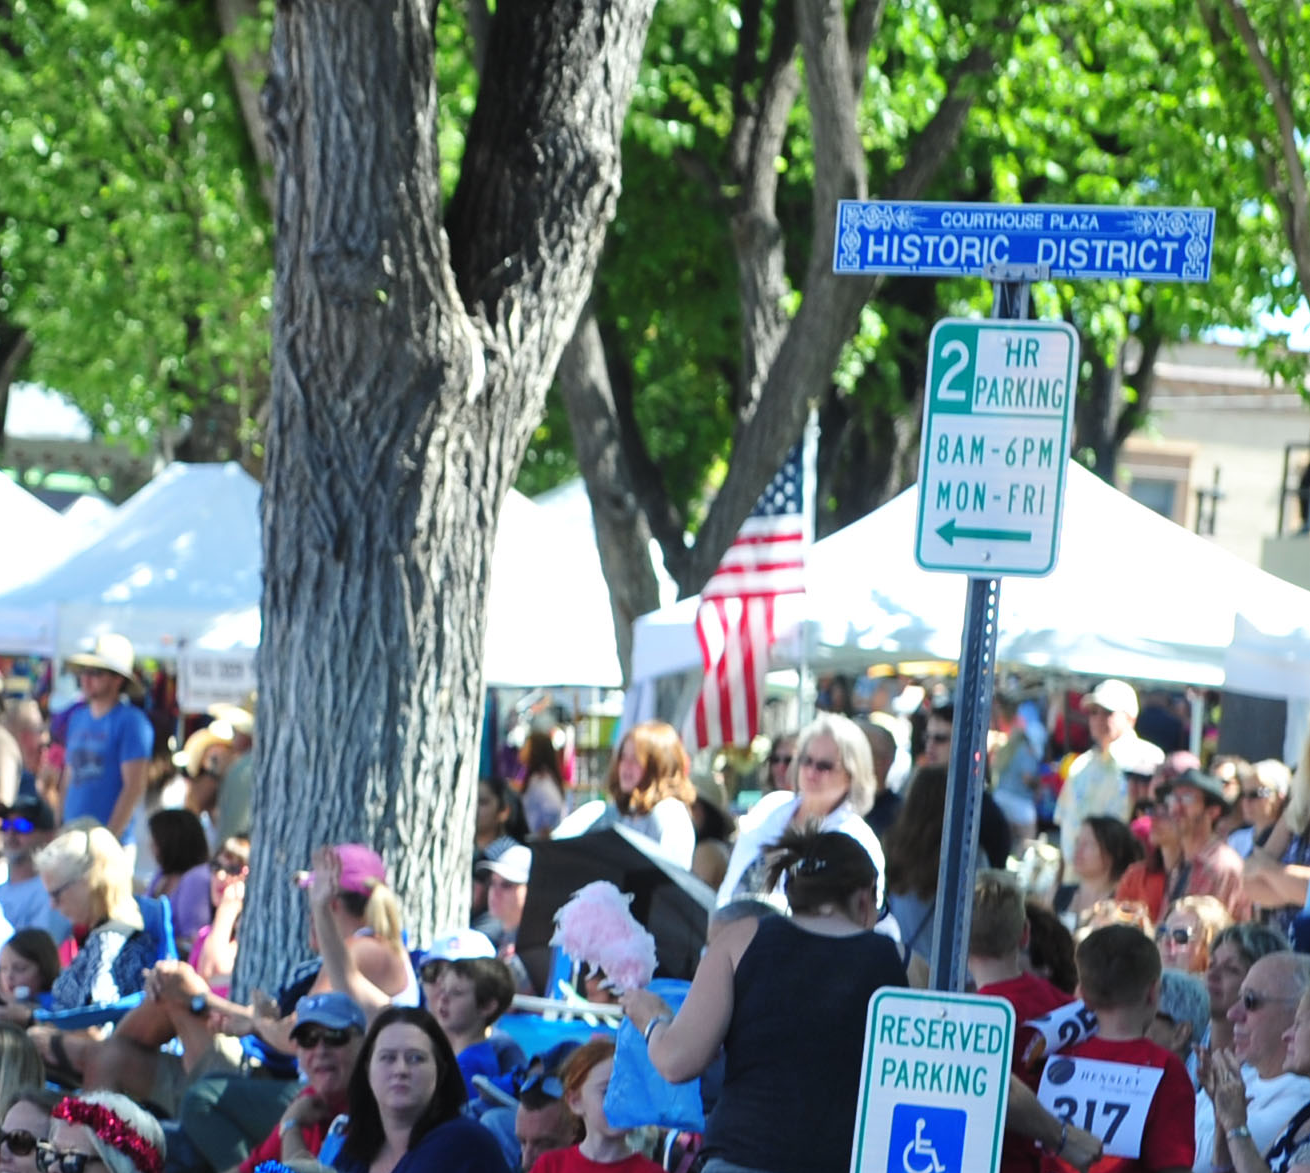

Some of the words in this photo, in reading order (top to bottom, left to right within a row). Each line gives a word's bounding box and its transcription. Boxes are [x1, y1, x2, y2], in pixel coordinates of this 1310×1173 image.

[941, 211, 1044, 229] COURTHOUSE
[1050, 213, 1100, 231] PLAZA
[867, 234, 1010, 265] HISTORIC
[1037, 237, 1179, 270] DISTRICT
[937, 339, 969, 401] 2
[1006, 338, 1040, 368] HR
[974, 376, 1064, 409] PARKING
[880, 1014, 1003, 1055] RESERVED
[880, 1057, 988, 1097] PARKING
[1053, 1096, 1132, 1145] 317
